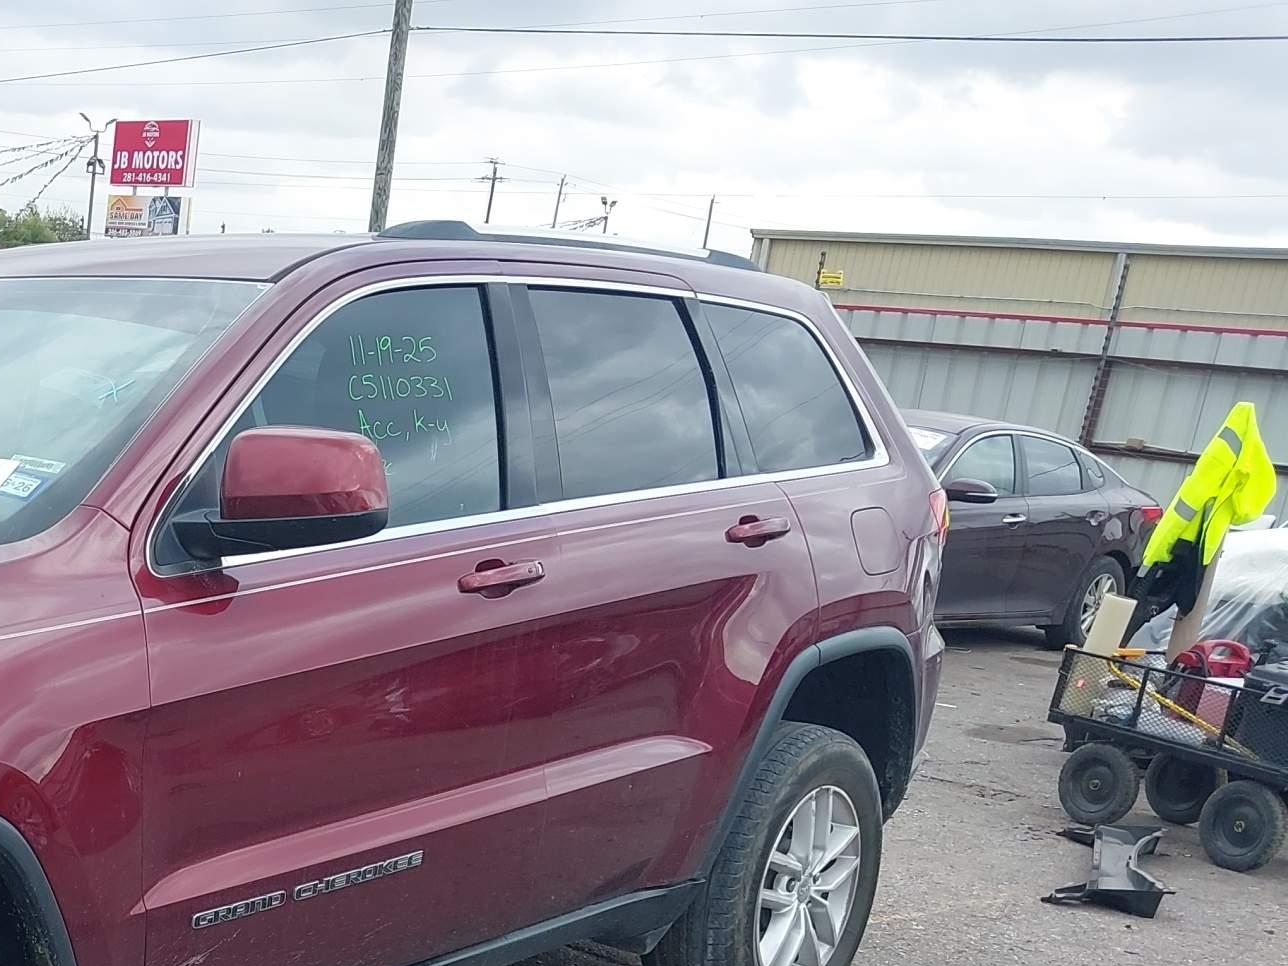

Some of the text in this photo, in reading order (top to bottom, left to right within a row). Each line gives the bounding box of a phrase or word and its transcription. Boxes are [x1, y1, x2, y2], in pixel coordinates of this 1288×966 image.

[114, 150, 184, 169] JB MOTORS
[122, 173, 171, 182] 281-416-4341
[349, 335, 437, 366] 11-19-25
[348, 374, 453, 401] C5110331
[192, 849, 424, 930] GRAND CHEROKEE
